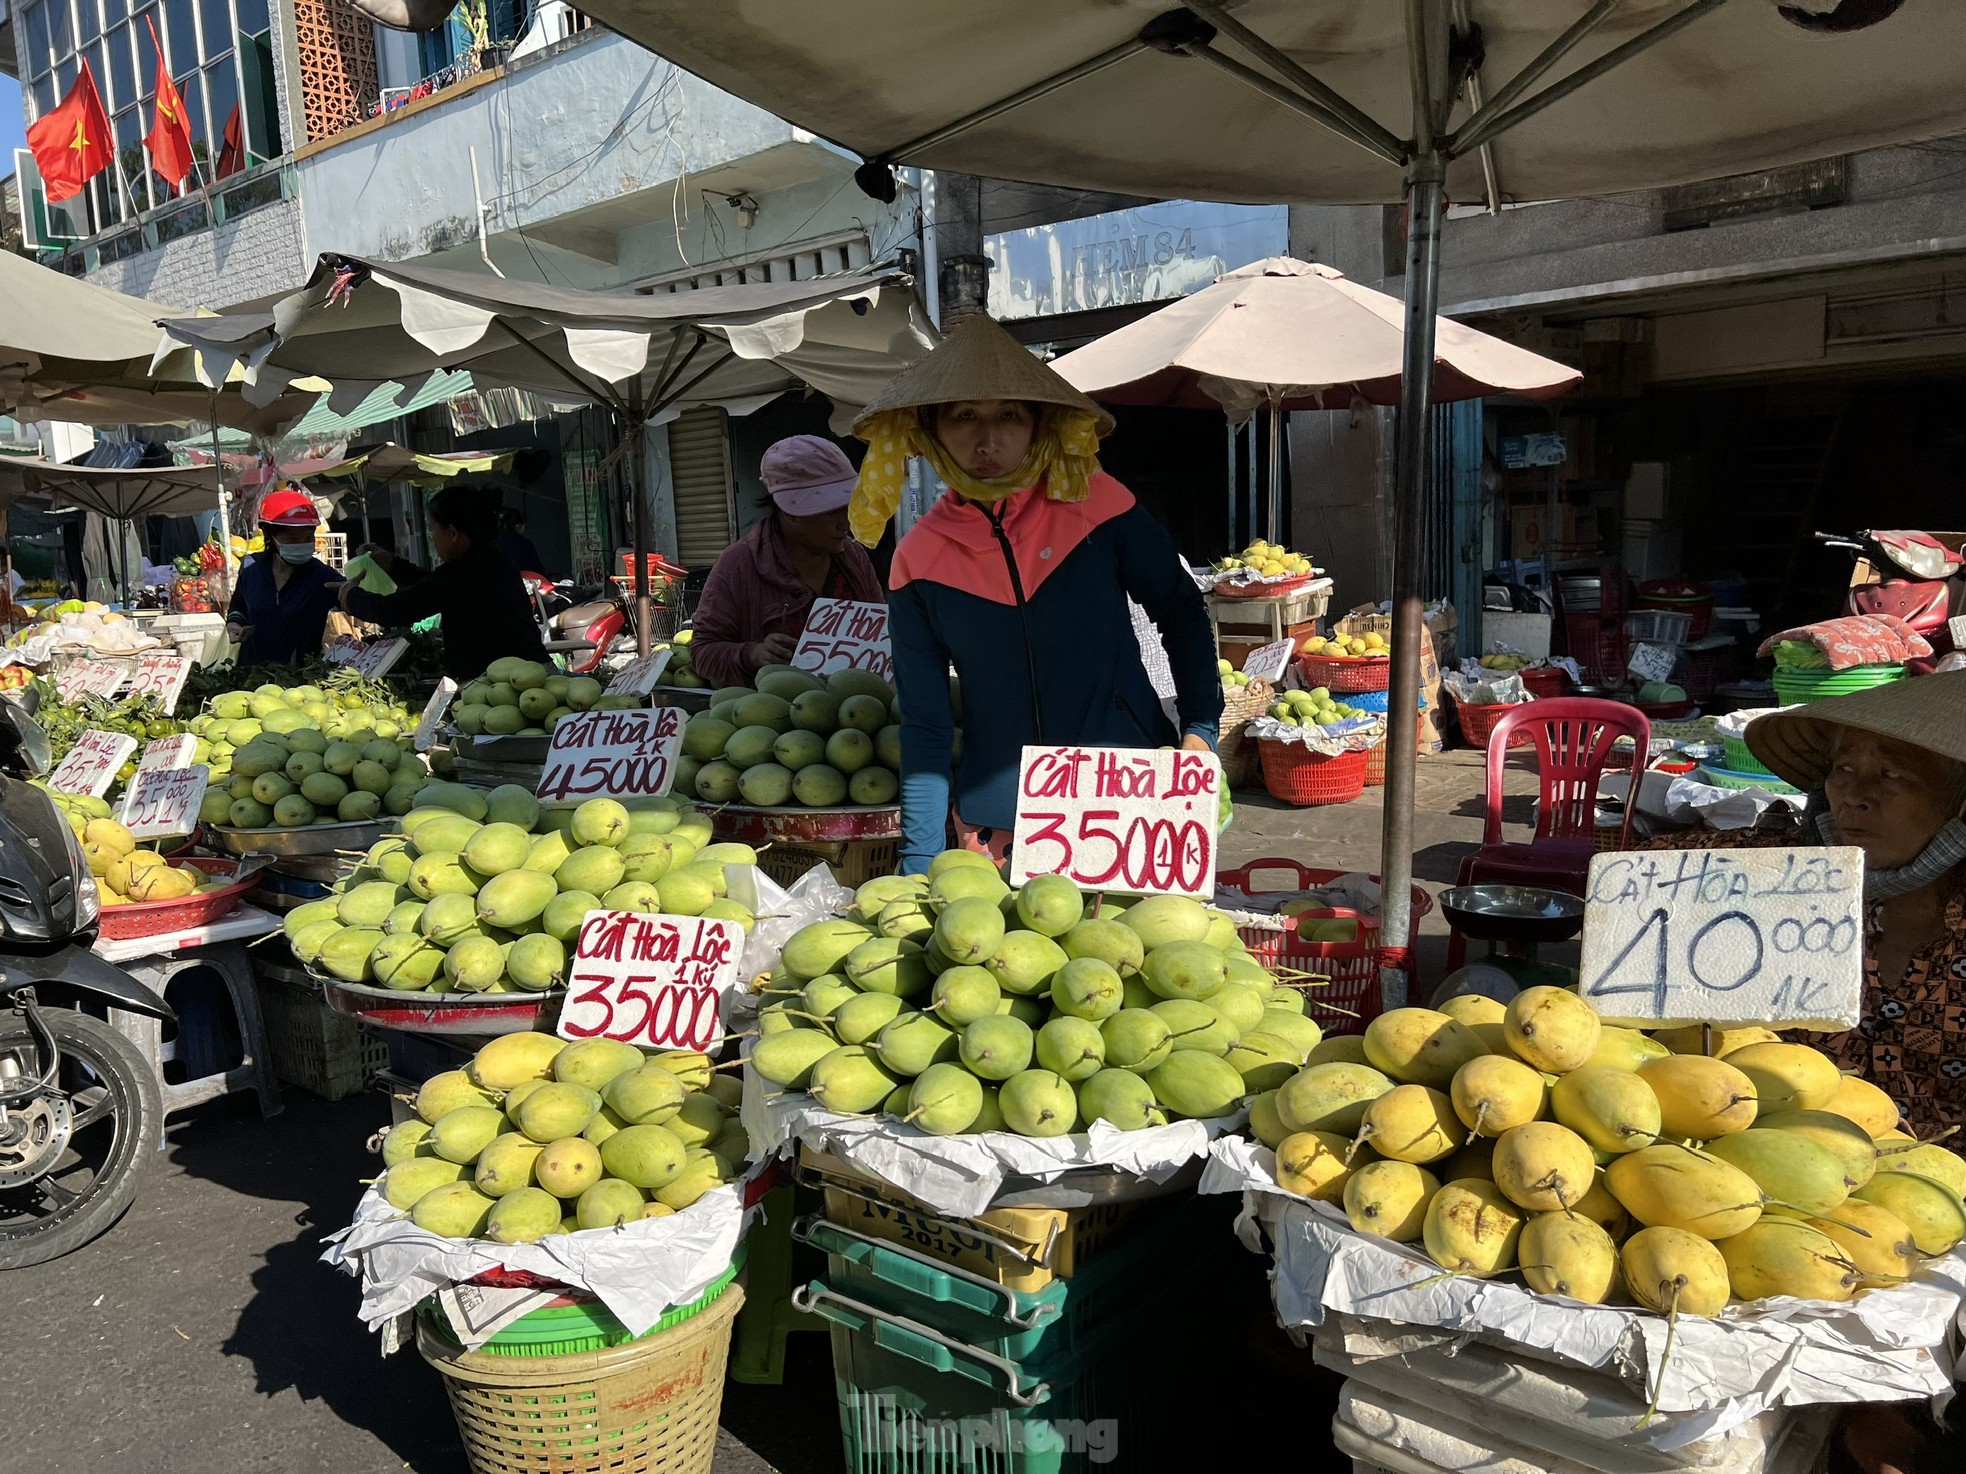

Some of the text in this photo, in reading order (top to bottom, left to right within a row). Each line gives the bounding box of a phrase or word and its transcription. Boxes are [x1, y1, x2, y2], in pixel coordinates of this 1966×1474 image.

[1072, 224, 1197, 279] HẺM 84
[805, 600, 855, 637] Cát
[552, 711, 610, 750] Cát
[536, 756, 668, 801] 45000
[1023, 747, 1092, 799] Cát
[1020, 810, 1210, 892] 35000
[575, 911, 640, 963] Cát
[563, 974, 720, 1053] 35000
[901, 1226, 963, 1257] 2017
